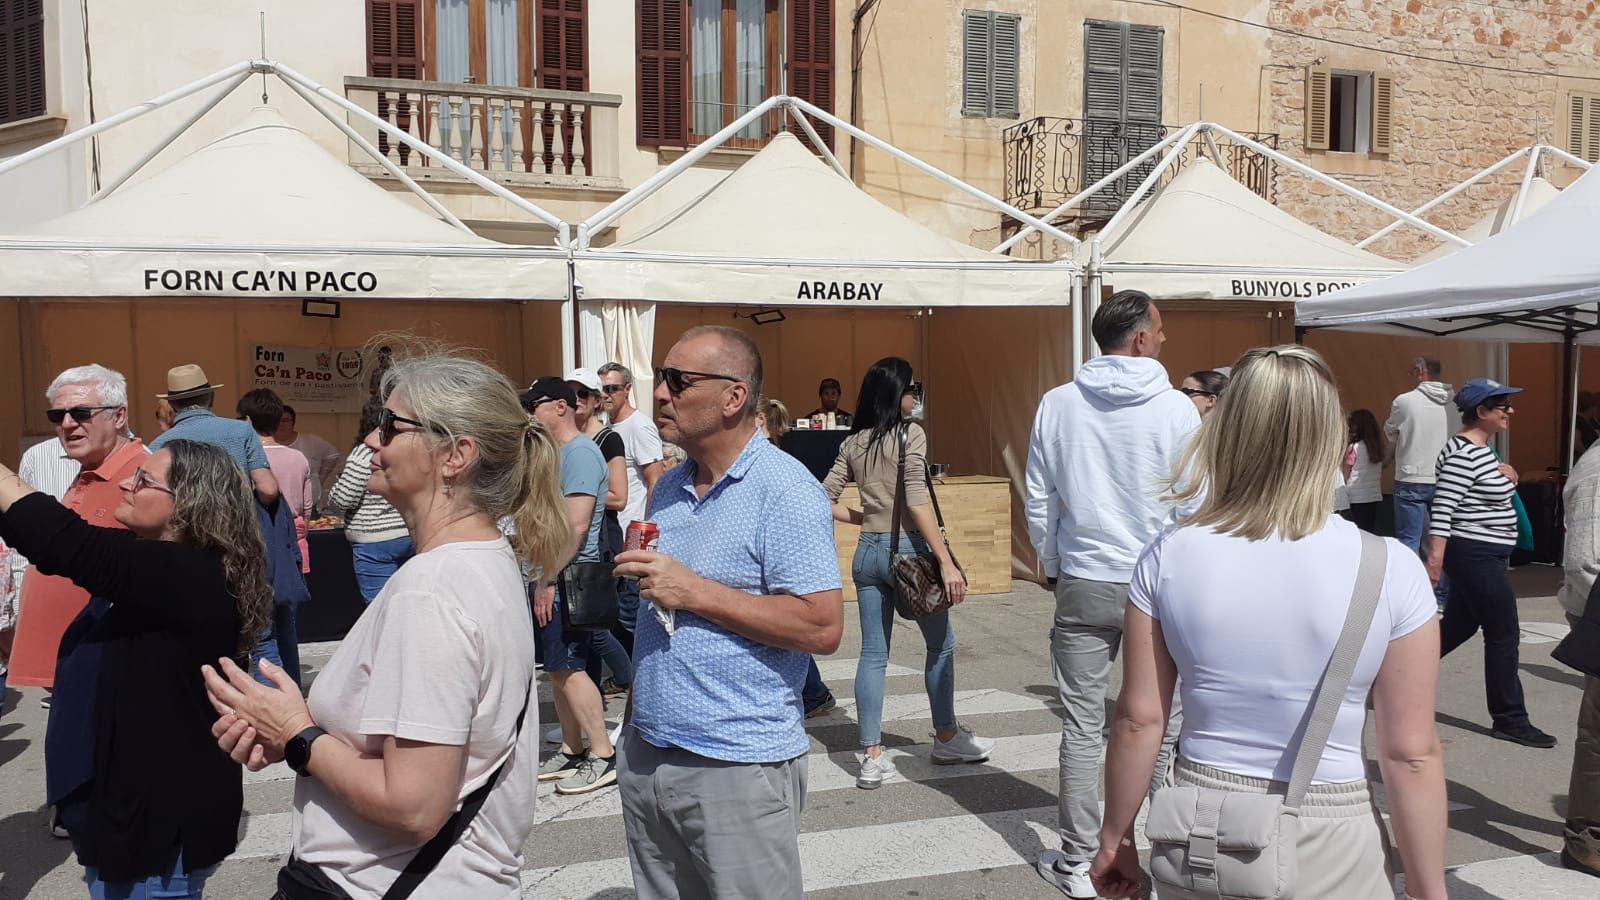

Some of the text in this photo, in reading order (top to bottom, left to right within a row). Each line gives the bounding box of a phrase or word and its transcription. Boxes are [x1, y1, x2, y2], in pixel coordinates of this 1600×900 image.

[144, 269, 223, 291] FORN
[305, 271, 378, 292] PACO
[1231, 280, 1312, 298] BUNYOLS
[797, 281, 883, 300] ARABAY
[255, 345, 285, 362] Forn
[255, 378, 277, 386] Forn
[295, 367, 332, 381] Paco
